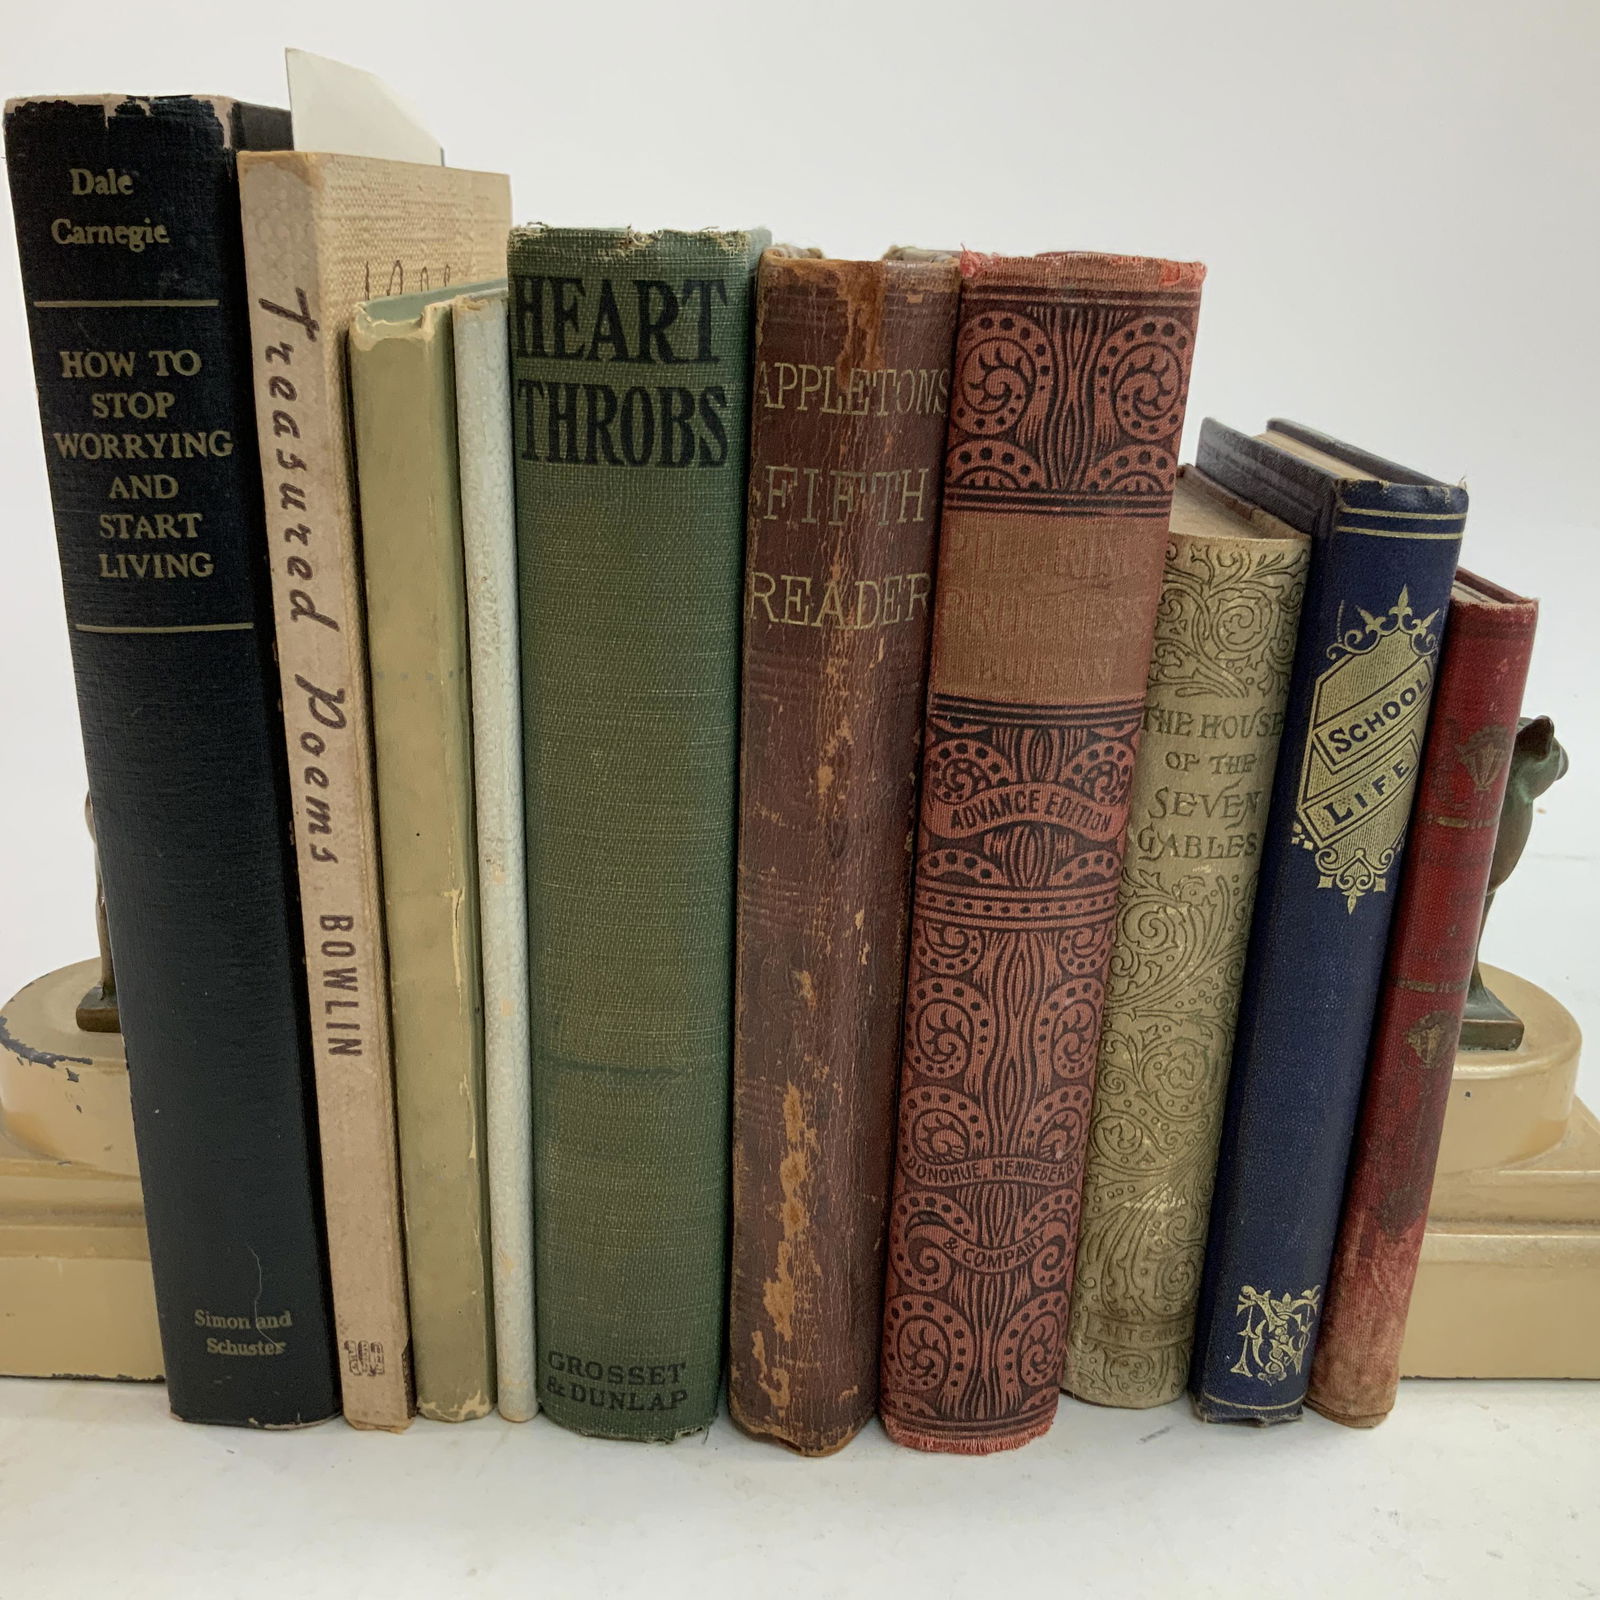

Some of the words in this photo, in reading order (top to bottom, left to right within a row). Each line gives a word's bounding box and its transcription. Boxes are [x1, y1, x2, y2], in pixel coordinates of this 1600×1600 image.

[69, 168, 134, 196] Dale
[51, 217, 170, 253] Carnegie
[513, 275, 729, 365] HEART
[59, 351, 135, 378] HOW
[149, 350, 202, 376] TO
[91, 391, 176, 419] STOP
[517, 379, 728, 467] THROBS
[53, 430, 234, 460] WORRYING
[257, 287, 341, 632] Treasured
[109, 474, 179, 500] AND
[763, 464, 929, 526] FIFTH
[100, 513, 203, 540] START
[99, 552, 215, 579] LIVING
[750, 571, 932, 629] READER
[1198, 706, 1284, 739] HOUSE
[1328, 678, 1428, 754] SCHOOL
[294, 673, 347, 866] Poems
[1165, 751, 1200, 772] OF
[1208, 752, 1257, 775] THE
[1148, 779, 1262, 830] SEVEN
[1323, 758, 1410, 825] LIFE
[950, 789, 1041, 830] ADVANCE
[1044, 793, 1113, 833] EDITION
[1136, 822, 1257, 861] GABLES
[319, 914, 363, 1057] BOWLIN
[943, 1237, 959, 1256] &
[961, 1230, 1046, 1268] COMPANY
[194, 1309, 250, 1329] Simon
[256, 1310, 293, 1328] and
[206, 1338, 287, 1356] Schuster
[548, 1351, 686, 1386] GROSSET
[546, 1375, 566, 1398] &
[569, 1382, 689, 1412] DUNLAP
